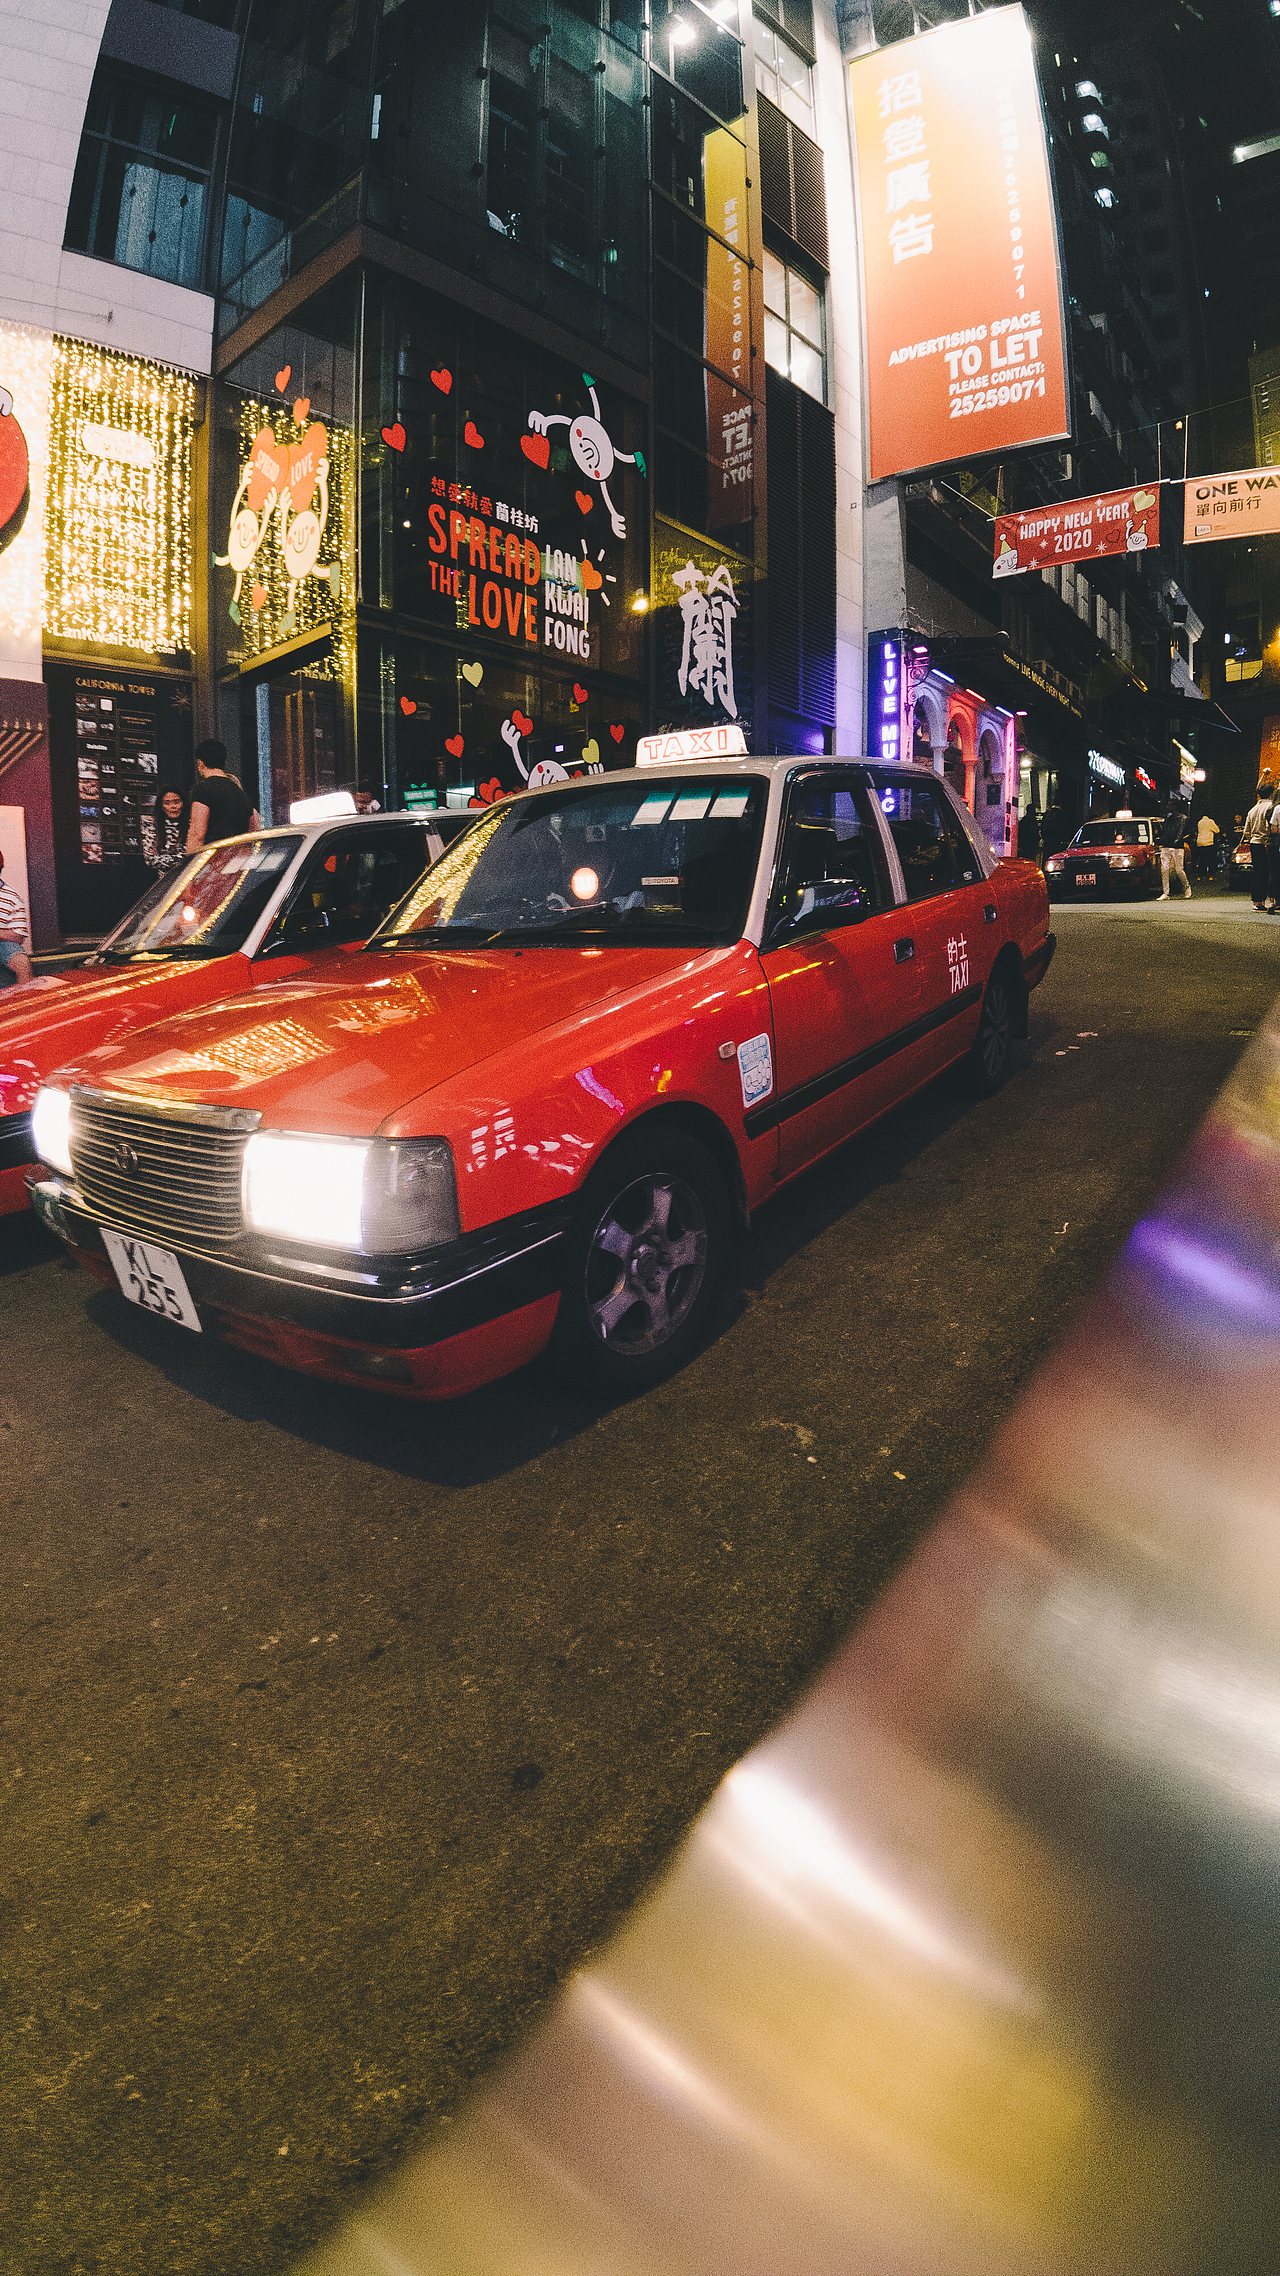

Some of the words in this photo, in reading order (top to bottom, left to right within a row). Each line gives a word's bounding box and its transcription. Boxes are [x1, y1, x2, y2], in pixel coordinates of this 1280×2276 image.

[877, 69, 934, 265] 招登廣告
[888, 324, 987, 367] ADVERTISING
[990, 310, 1041, 337] SPACE
[944, 345, 982, 380] TO
[989, 328, 1043, 369] LET
[949, 374, 989, 396] PLEASE
[991, 361, 1045, 385] CONTACT:
[949, 377, 1046, 419] 25259071
[255, 450, 280, 482] SPREAD
[291, 451, 314, 486] LOVE
[1195, 481, 1238, 500] ONE
[1195, 495, 1262, 517] 單向前行
[495, 501, 539, 534] 蘭桂坊
[1020, 516, 1061, 540] HAPPY
[1064, 510, 1093, 531] NEW
[1096, 501, 1130, 523] YEAR
[427, 503, 542, 586] SPREAD
[1053, 528, 1092, 553] 2020
[545, 544, 577, 583] LAN
[428, 560, 462, 599] THE
[469, 574, 538, 642] LOVE
[544, 580, 589, 624] KWAI
[544, 616, 590, 659] FONG
[75, 677, 125, 692] CALIFORNIA
[128, 684, 156, 696] TOWER
[883, 643, 897, 713] LIVE
[643, 729, 728, 760] TAXI
[947, 933, 968, 964] 的士
[948, 959, 969, 993] TAXI
[120, 1239, 164, 1283] KL
[130, 1273, 184, 1321] 255
